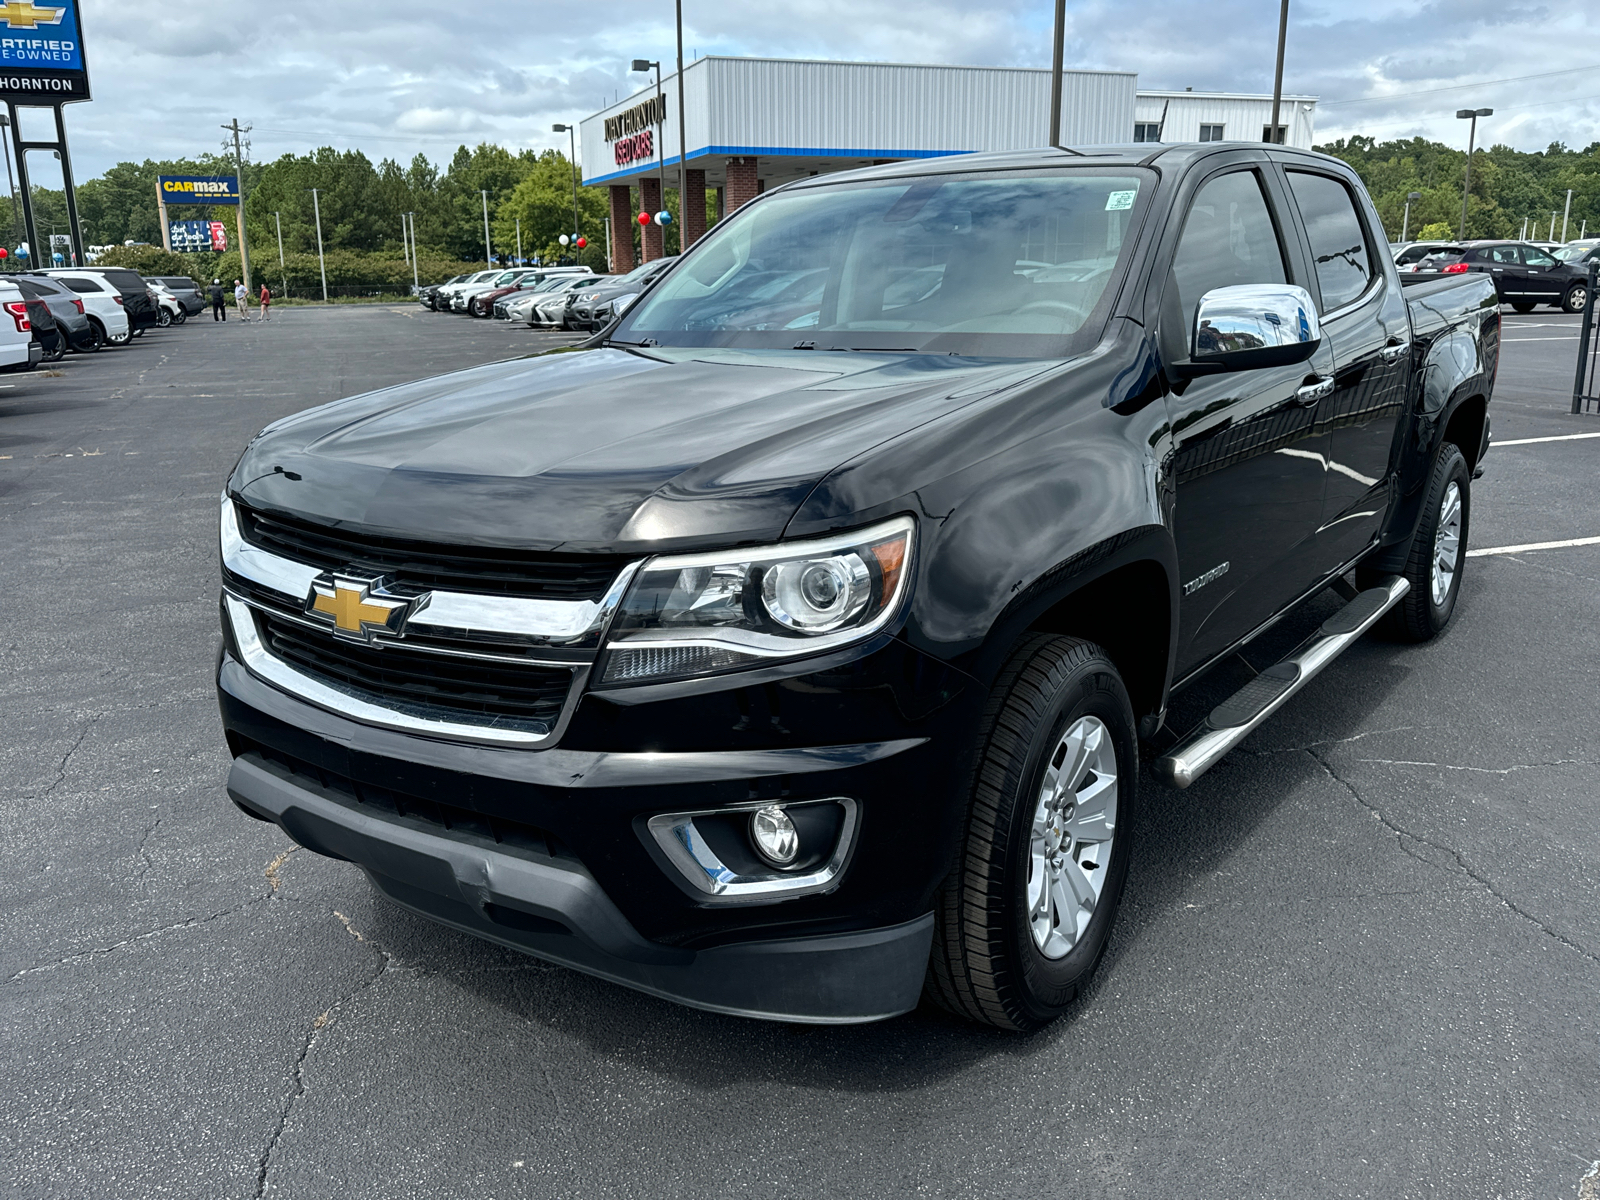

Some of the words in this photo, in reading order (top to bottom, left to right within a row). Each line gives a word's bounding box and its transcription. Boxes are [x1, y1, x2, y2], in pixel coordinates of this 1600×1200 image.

[0, 38, 75, 51] RTIFIED
[2, 49, 71, 61] E-OWNED
[0, 77, 73, 91] HORNTON
[614, 138, 633, 165] USED
[631, 130, 654, 160] CARS
